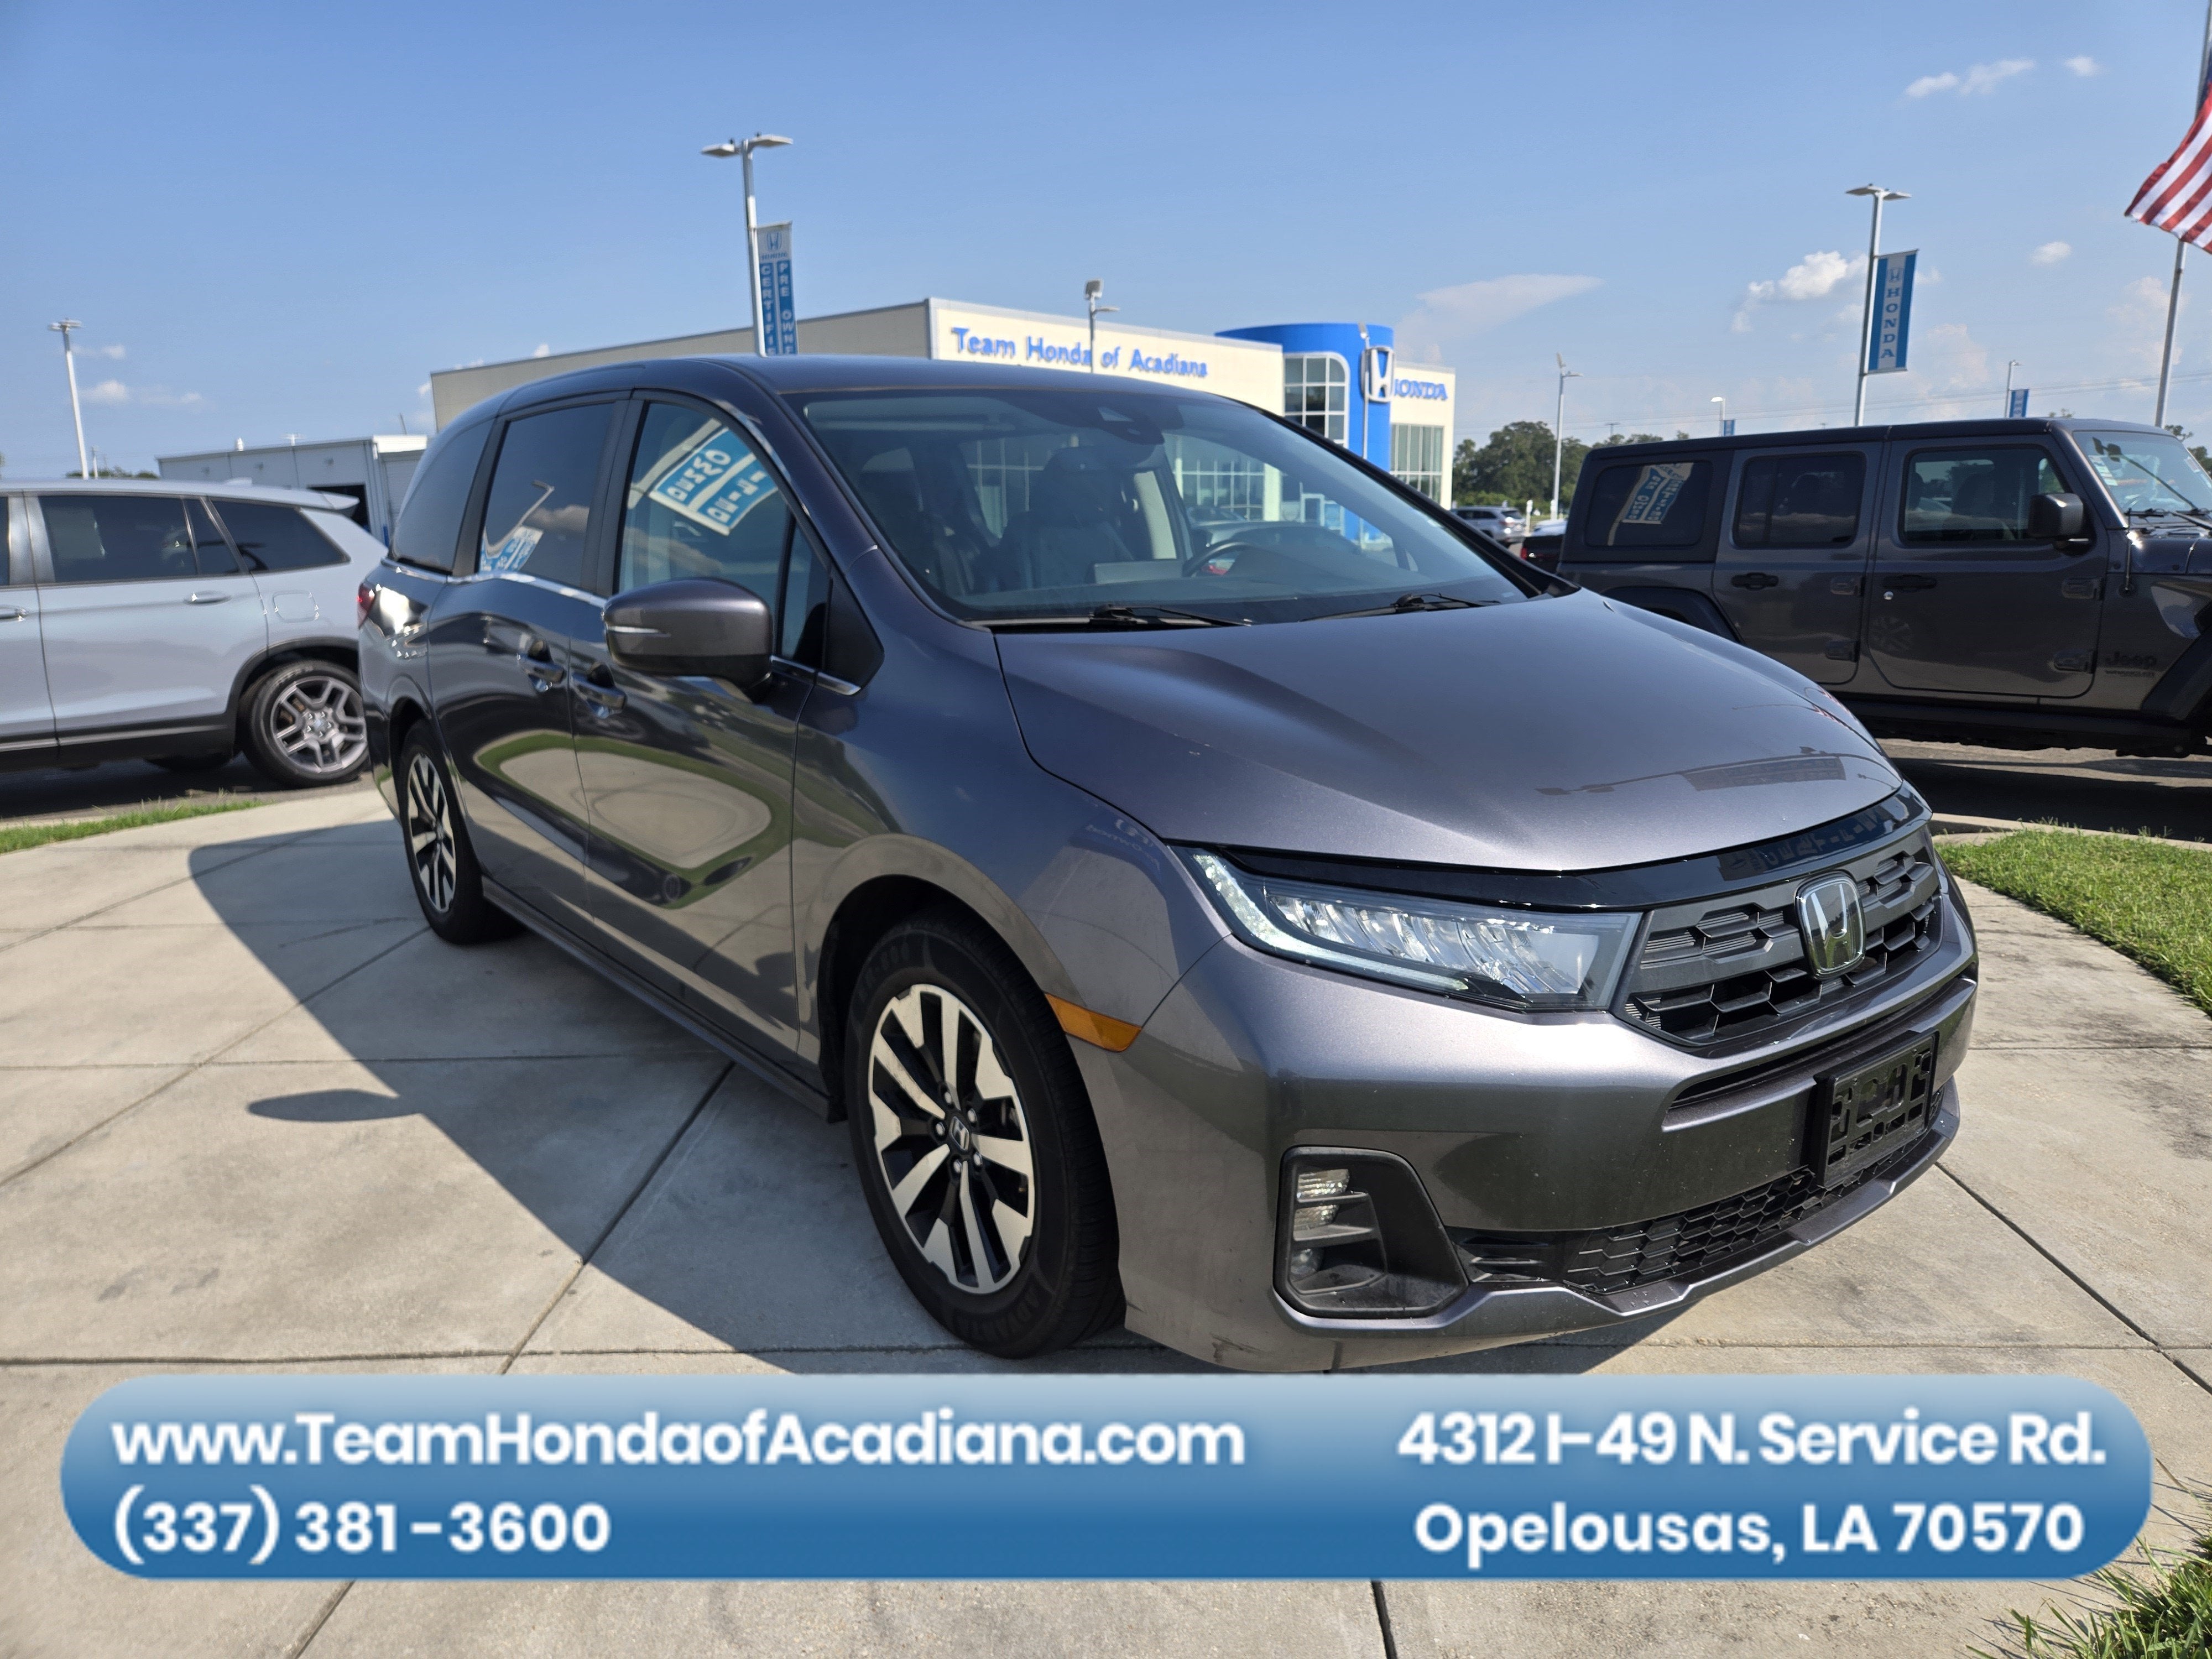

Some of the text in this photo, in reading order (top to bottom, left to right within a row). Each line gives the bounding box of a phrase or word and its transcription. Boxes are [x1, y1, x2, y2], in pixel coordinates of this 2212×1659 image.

[778, 262, 790, 297] PRE
[1881, 288, 1900, 358] HONDA
[952, 327, 1208, 377] Team Honda of Acadiana
